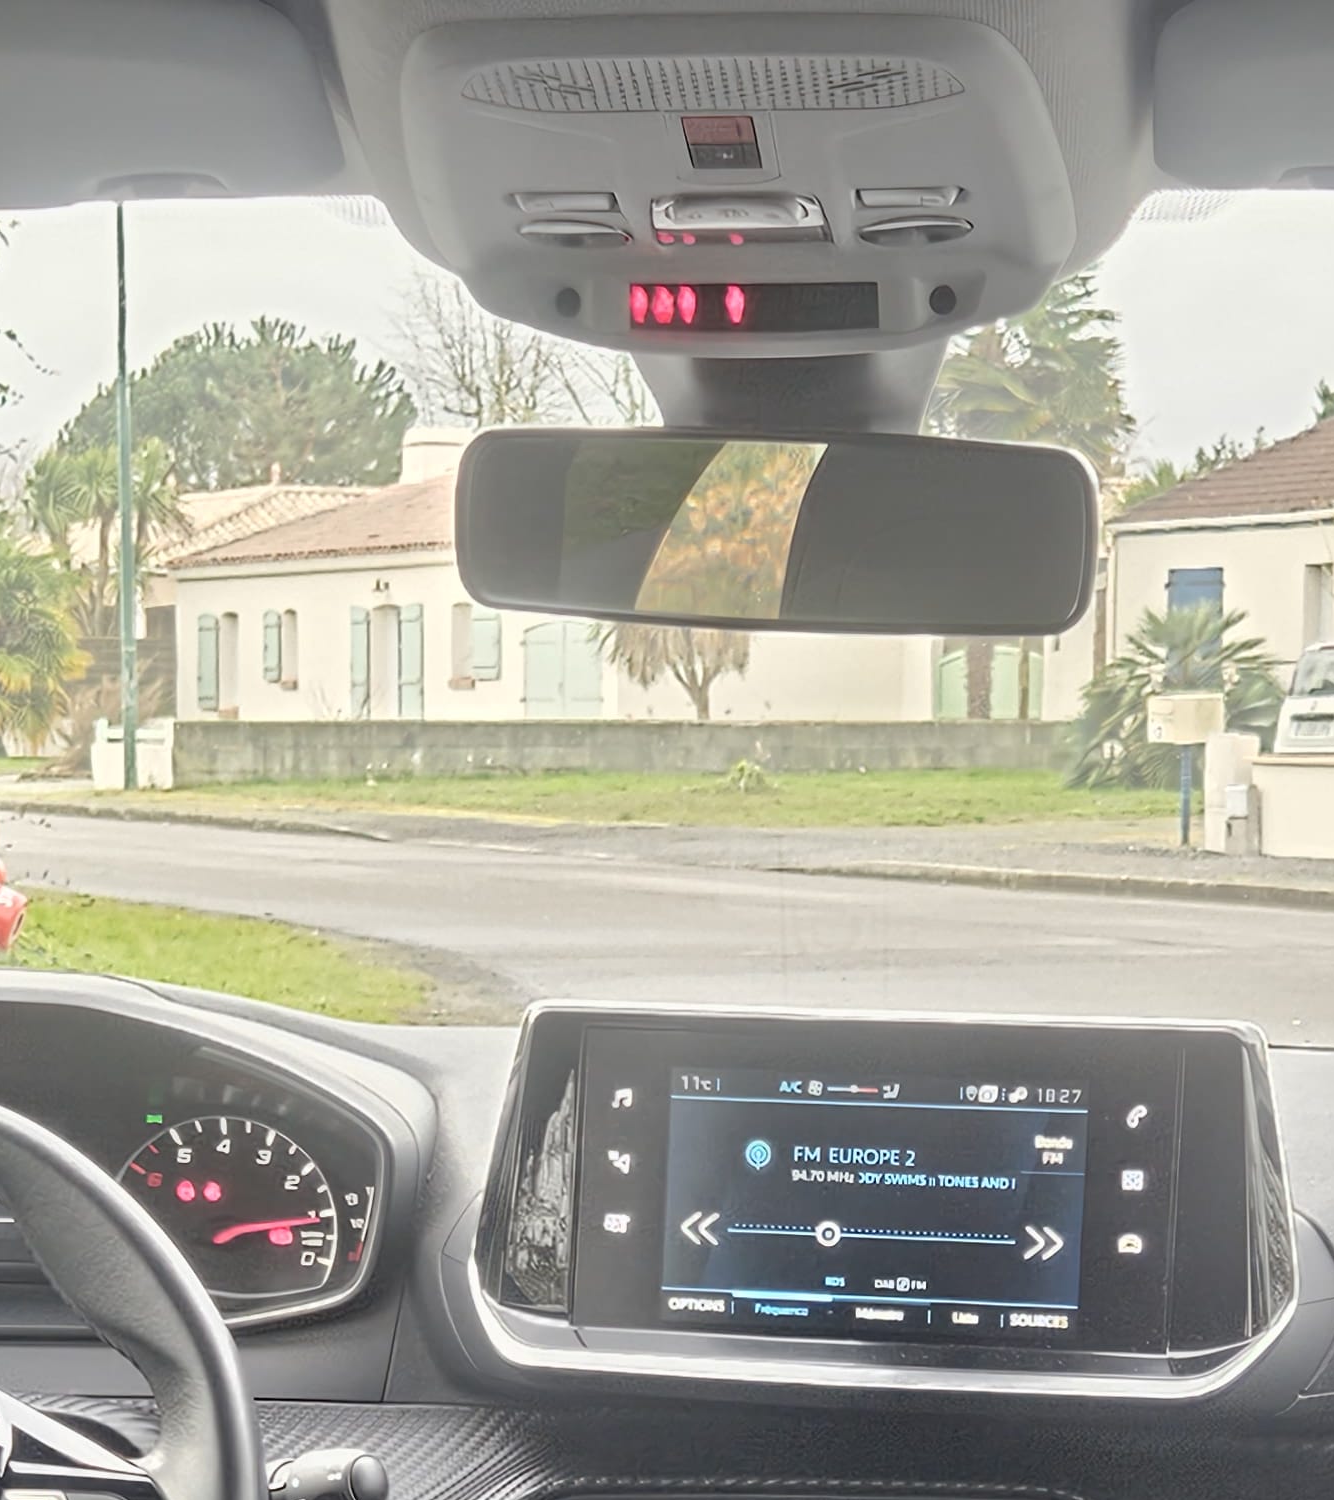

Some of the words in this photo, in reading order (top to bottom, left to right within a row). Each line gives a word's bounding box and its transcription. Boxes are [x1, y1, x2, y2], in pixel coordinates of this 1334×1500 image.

[779, 1080, 803, 1094] A/C
[216, 1138, 231, 1154] 4
[176, 1148, 193, 1164] 5
[255, 1149, 273, 1165] 3
[793, 1146, 821, 1162] FM
[828, 1147, 899, 1165] EUROPE
[904, 1150, 916, 1166] 2
[284, 1175, 301, 1190] 2
[884, 1173, 927, 1187] SWIMS
[938, 1175, 979, 1188] TONES
[981, 1176, 1010, 1190] AND
[668, 1297, 725, 1312] OPTIONS
[1009, 1313, 1069, 1329] SOURCES
